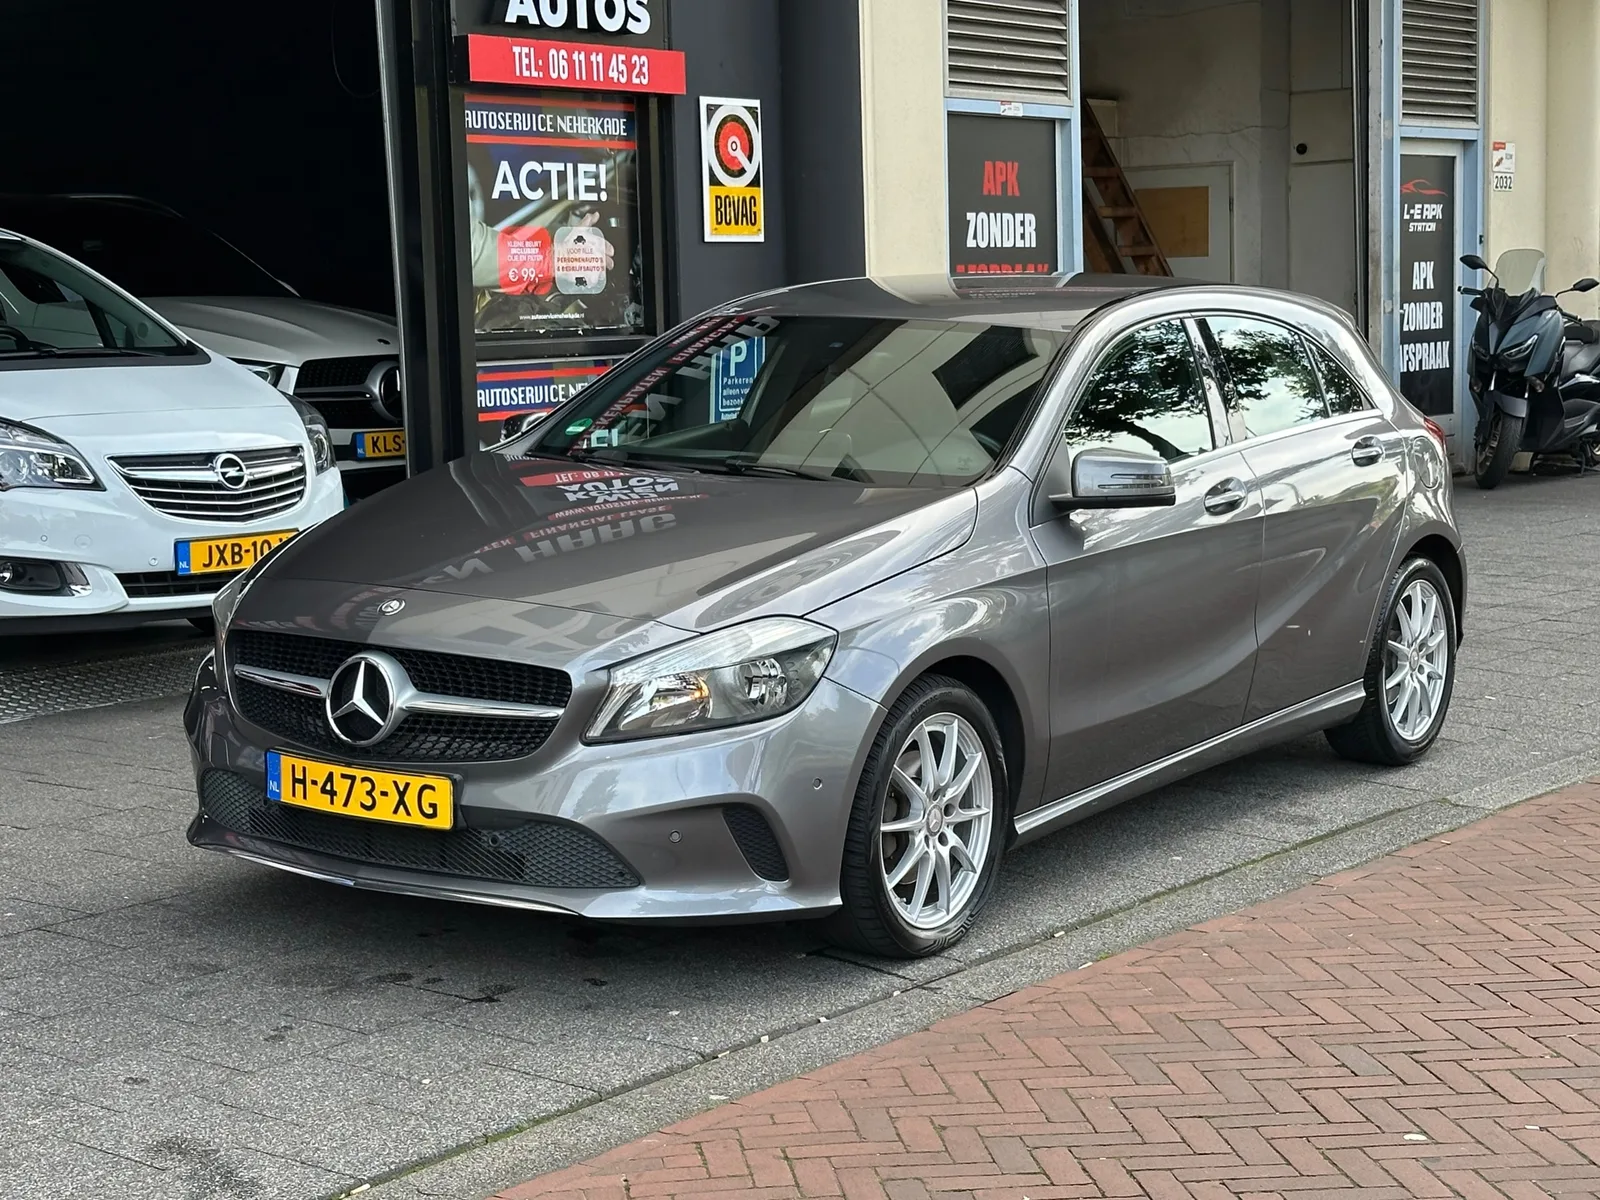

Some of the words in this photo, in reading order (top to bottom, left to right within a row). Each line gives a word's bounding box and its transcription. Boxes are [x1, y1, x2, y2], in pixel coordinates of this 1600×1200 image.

[505, 0, 650, 34] AUTOS
[512, 46, 543, 78] TEL:
[548, 48, 569, 80] 06
[572, 51, 586, 81] 11
[590, 52, 604, 82] 11
[608, 53, 627, 84] 45
[631, 55, 649, 85] 23
[465, 110, 554, 133] AUTOSERVICE
[557, 115, 628, 136] NEHERKADE
[491, 160, 608, 202] ACTIE!
[982, 160, 1021, 197] APK
[1494, 175, 1513, 190] 2032
[715, 195, 757, 227] BOVAG
[1422, 203, 1443, 219] APK
[966, 211, 1037, 248] ZONDER
[1408, 222, 1436, 232] STATION
[508, 268, 519, 282] €
[521, 268, 543, 284] 99,-
[1412, 261, 1434, 290] APK
[1402, 301, 1443, 332] ZONDER
[722, 388, 739, 396] alleen
[723, 377, 753, 385] Parkeren
[477, 384, 566, 408] AUTOSERVICE
[269, 781, 279, 793] NL
[291, 763, 438, 819] H-473-XG
